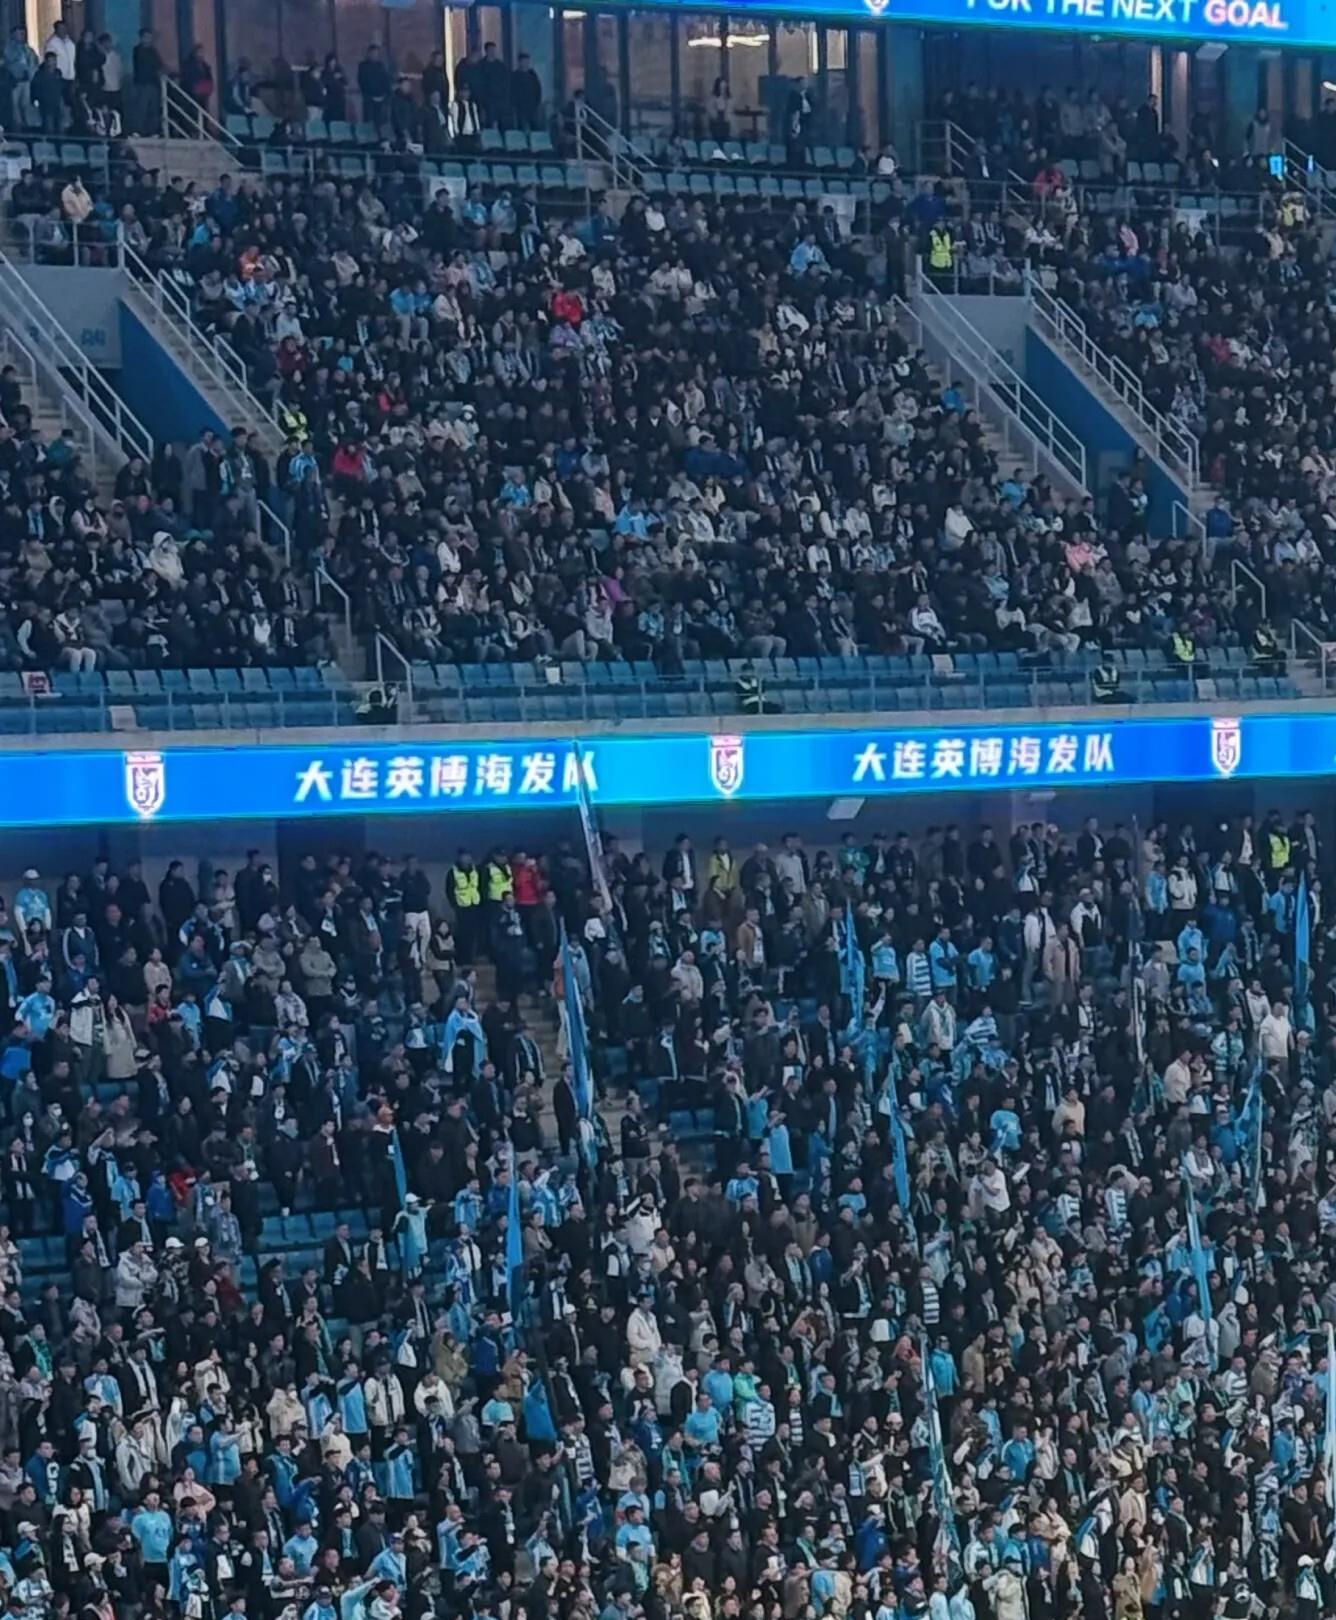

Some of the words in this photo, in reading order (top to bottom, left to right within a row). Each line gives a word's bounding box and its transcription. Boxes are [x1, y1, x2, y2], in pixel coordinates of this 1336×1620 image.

[1111, 0, 1198, 23] NEXT
[1204, 0, 1288, 29] GOAL
[294, 751, 599, 802] 大连英博海发队
[852, 732, 1115, 782] 大连英博海发队
